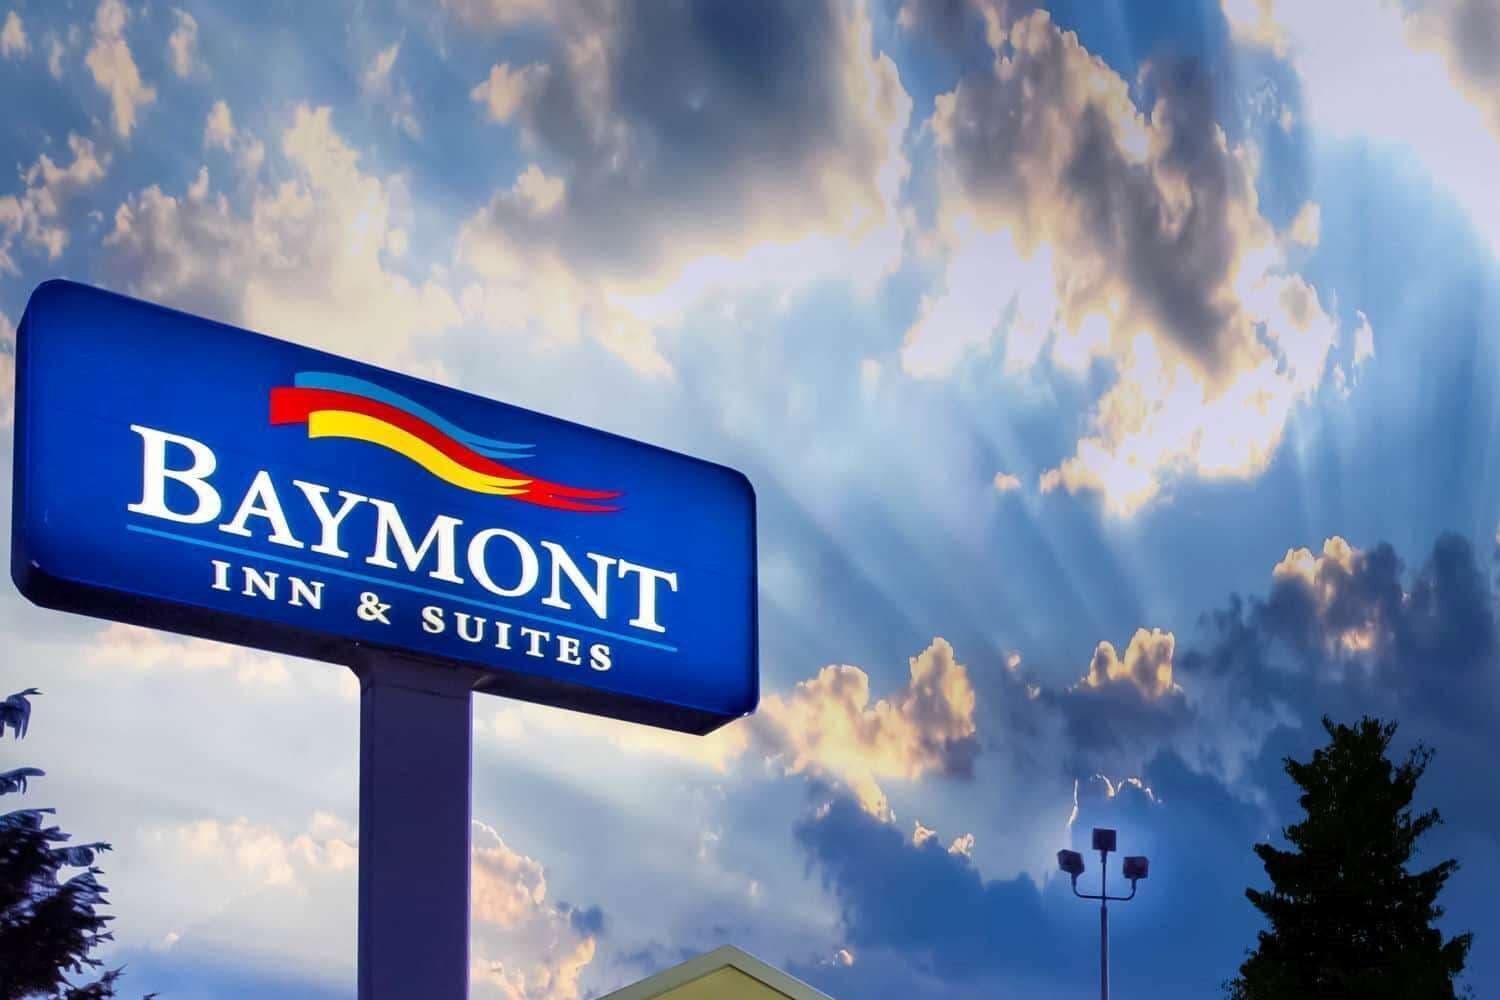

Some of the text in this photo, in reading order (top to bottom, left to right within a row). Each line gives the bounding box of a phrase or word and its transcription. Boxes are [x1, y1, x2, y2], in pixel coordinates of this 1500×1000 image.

[127, 425, 678, 632] BAYMONT
[211, 559, 613, 671] INN & SUITES
